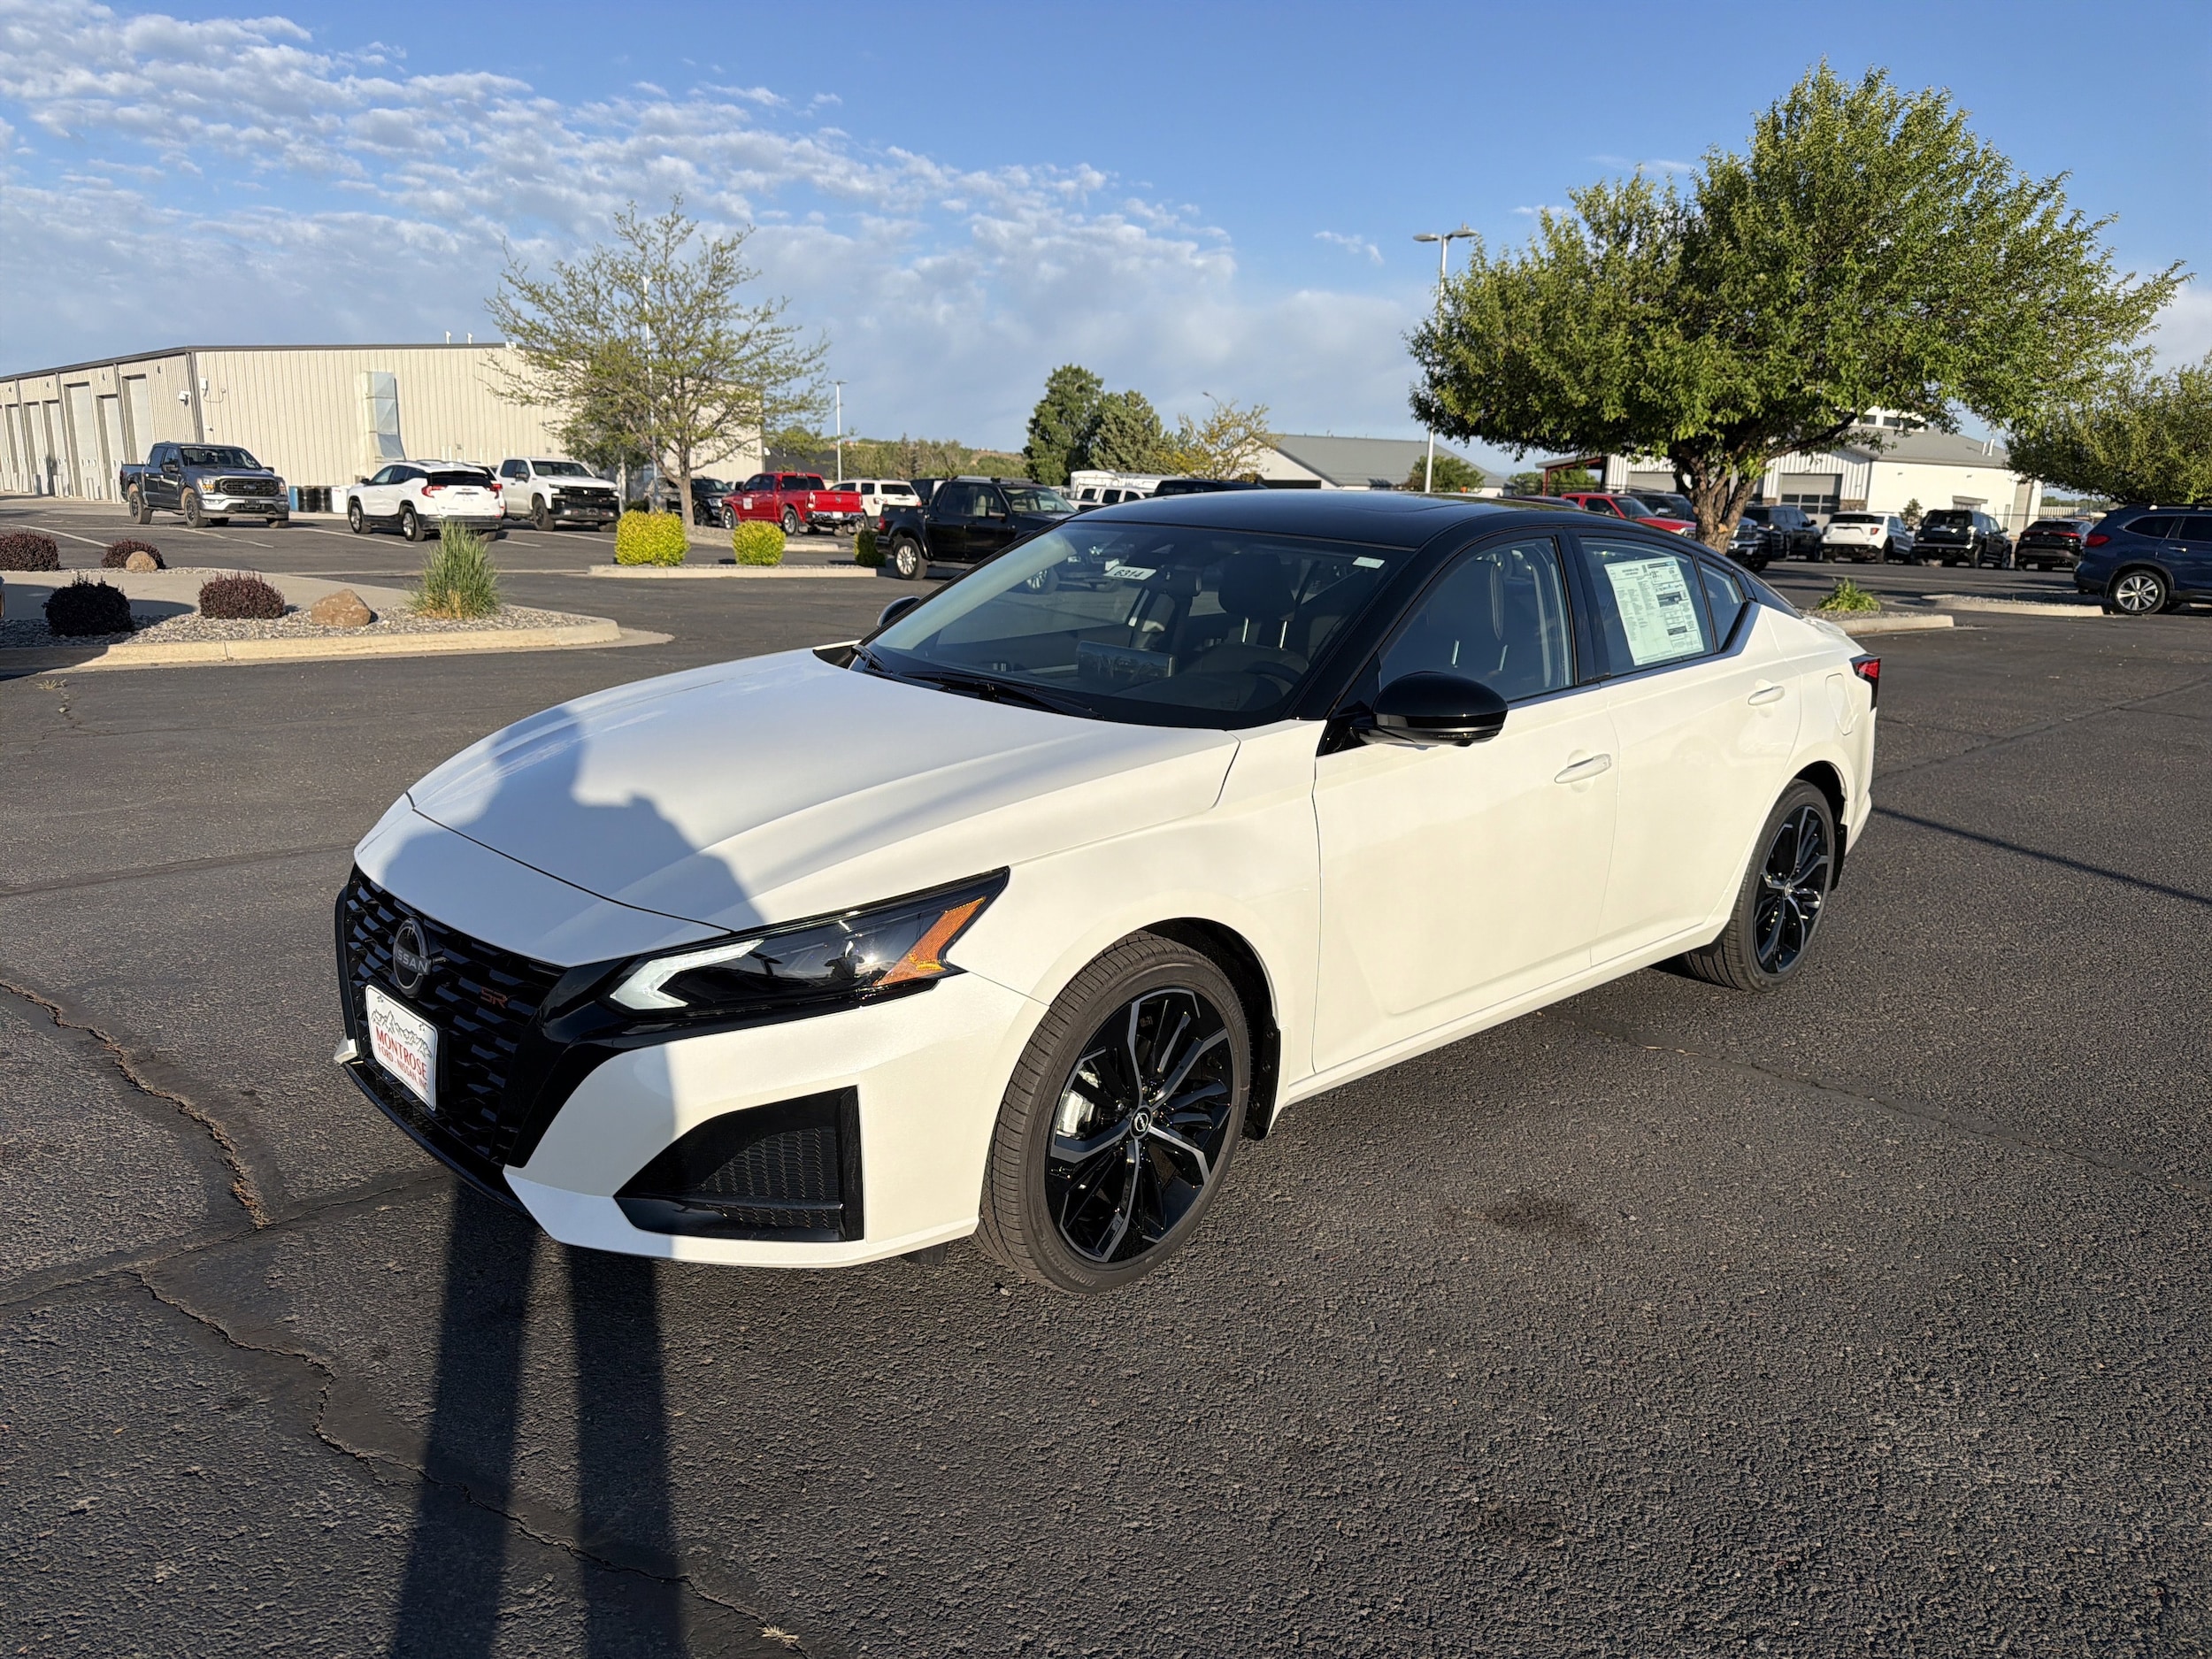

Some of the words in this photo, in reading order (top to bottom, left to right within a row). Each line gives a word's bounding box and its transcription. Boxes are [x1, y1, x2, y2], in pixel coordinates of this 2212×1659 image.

[1113, 569, 1144, 578] 6314
[396, 948, 428, 972] SSAN
[480, 986, 508, 1009] SR
[375, 1025, 427, 1080] MONTROSE
[378, 1043, 394, 1063] FORD
